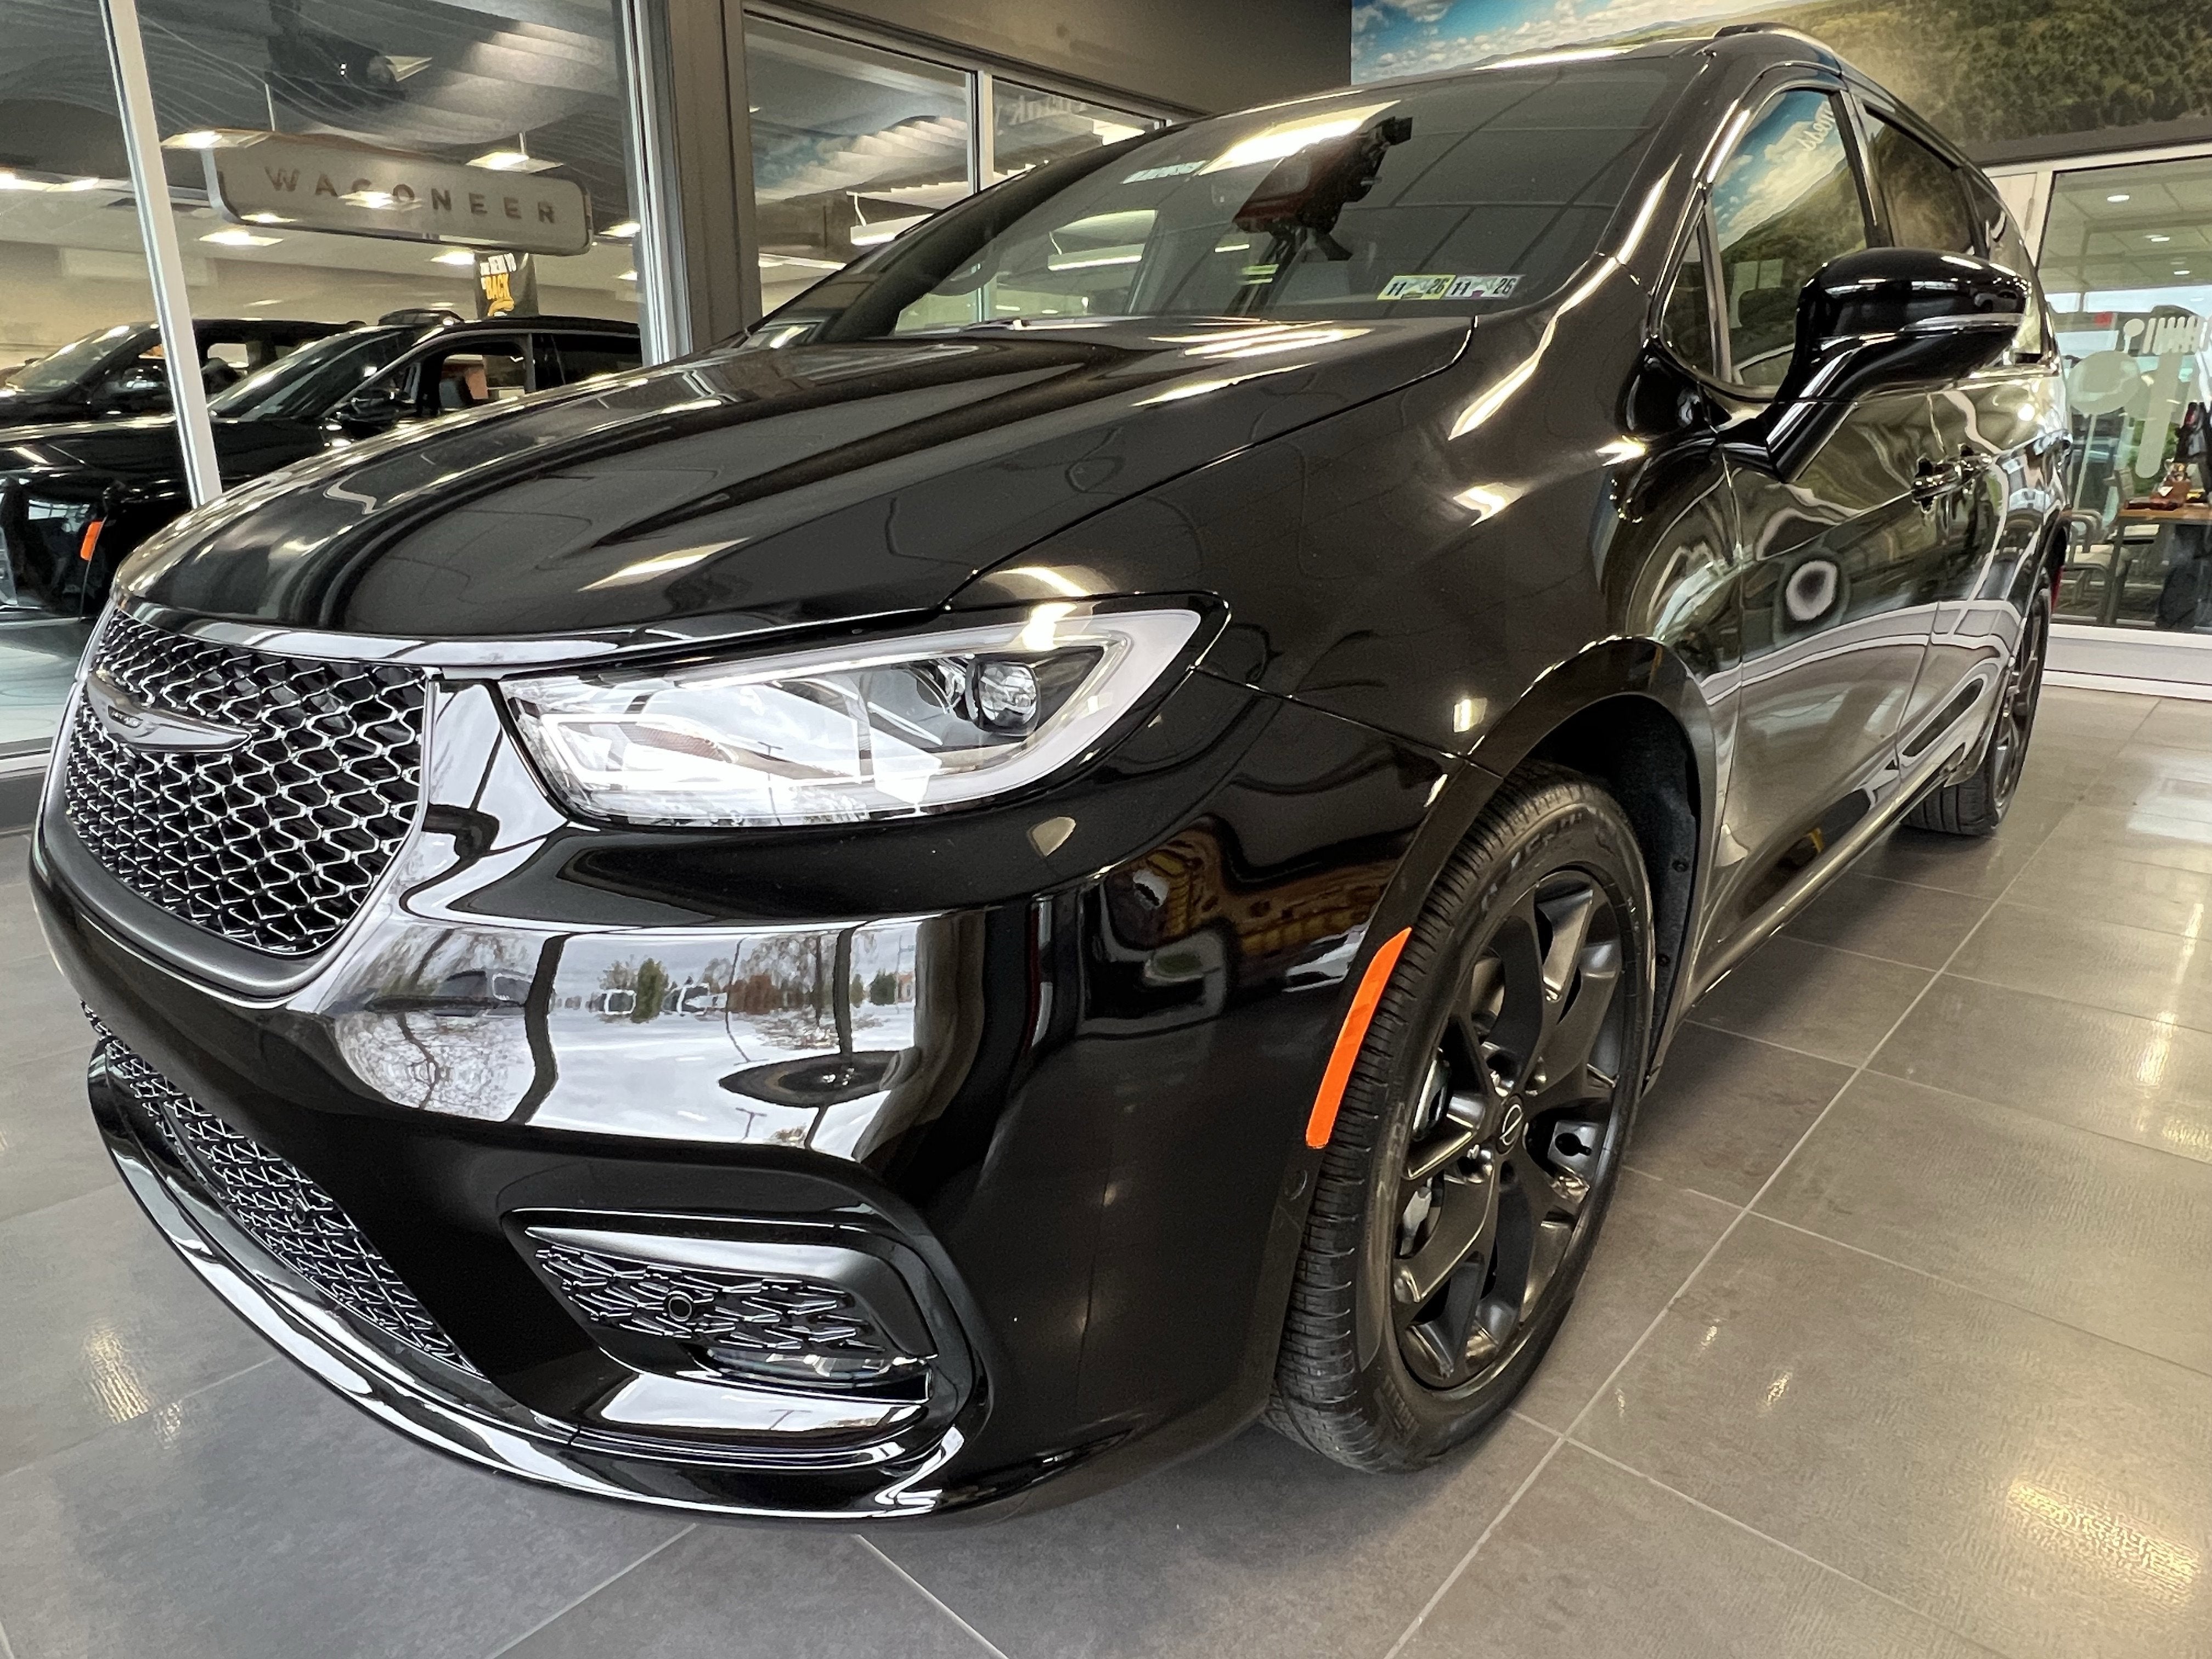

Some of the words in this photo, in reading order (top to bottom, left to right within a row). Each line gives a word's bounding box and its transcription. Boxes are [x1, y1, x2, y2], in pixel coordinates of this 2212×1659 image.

[1386, 281, 1408, 296] 11
[1426, 278, 1451, 295] 26
[1451, 281, 1472, 295] 11
[1492, 278, 1517, 295] 26
